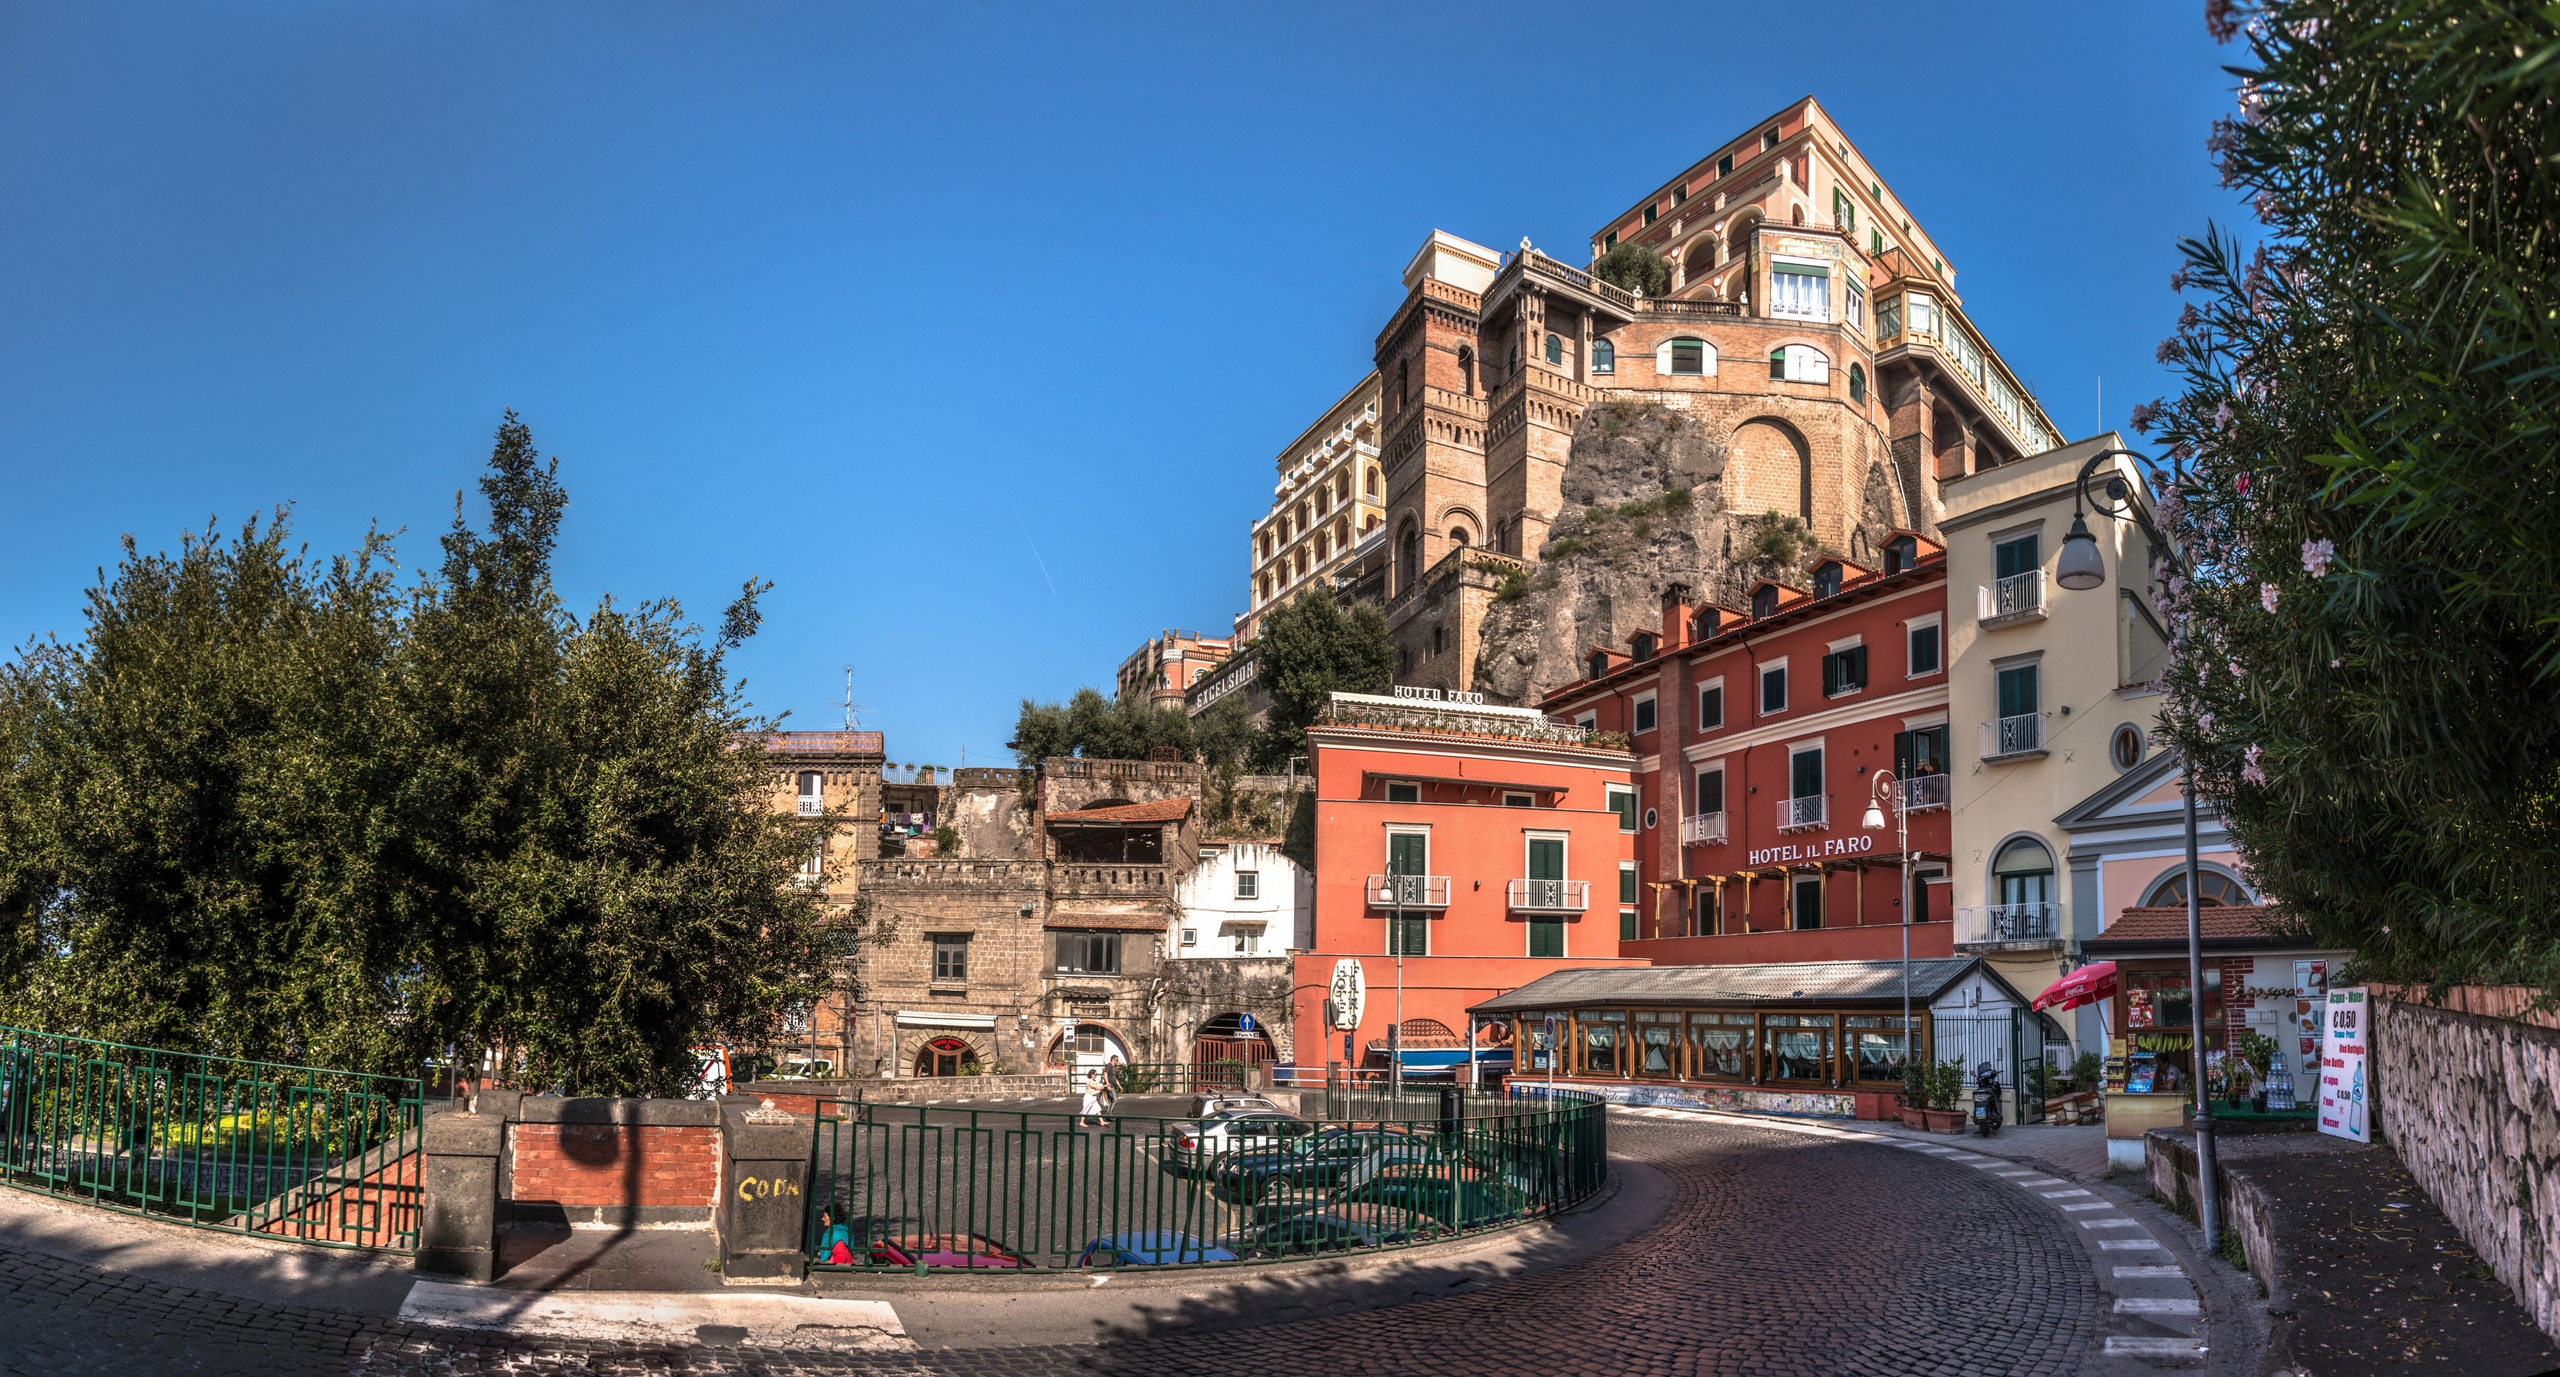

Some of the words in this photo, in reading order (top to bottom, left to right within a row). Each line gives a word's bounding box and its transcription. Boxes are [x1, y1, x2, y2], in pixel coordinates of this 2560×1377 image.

[1197, 661, 1253, 708] EXCELSIOR
[1394, 685, 1440, 700] HOTEL
[1448, 690, 1483, 704] FARO
[1749, 845, 1802, 865] HOTEL
[1806, 845, 1820, 858] IL
[1825, 835, 1872, 857] FARO
[2330, 992, 2345, 1004] Acqua
[2348, 991, 2364, 1003] Water
[2340, 1010, 2356, 1029] 0,50
[2339, 1044, 2347, 1053] Una
[2348, 1044, 2365, 1055] Bottiglia
[2323, 1057, 2331, 1067] One
[2332, 1057, 2345, 1068] Bottle
[2328, 1076, 2339, 1086] agua
[1597, 1087, 1639, 1104] Ristorante
[2322, 1116, 2339, 1128] Wasser
